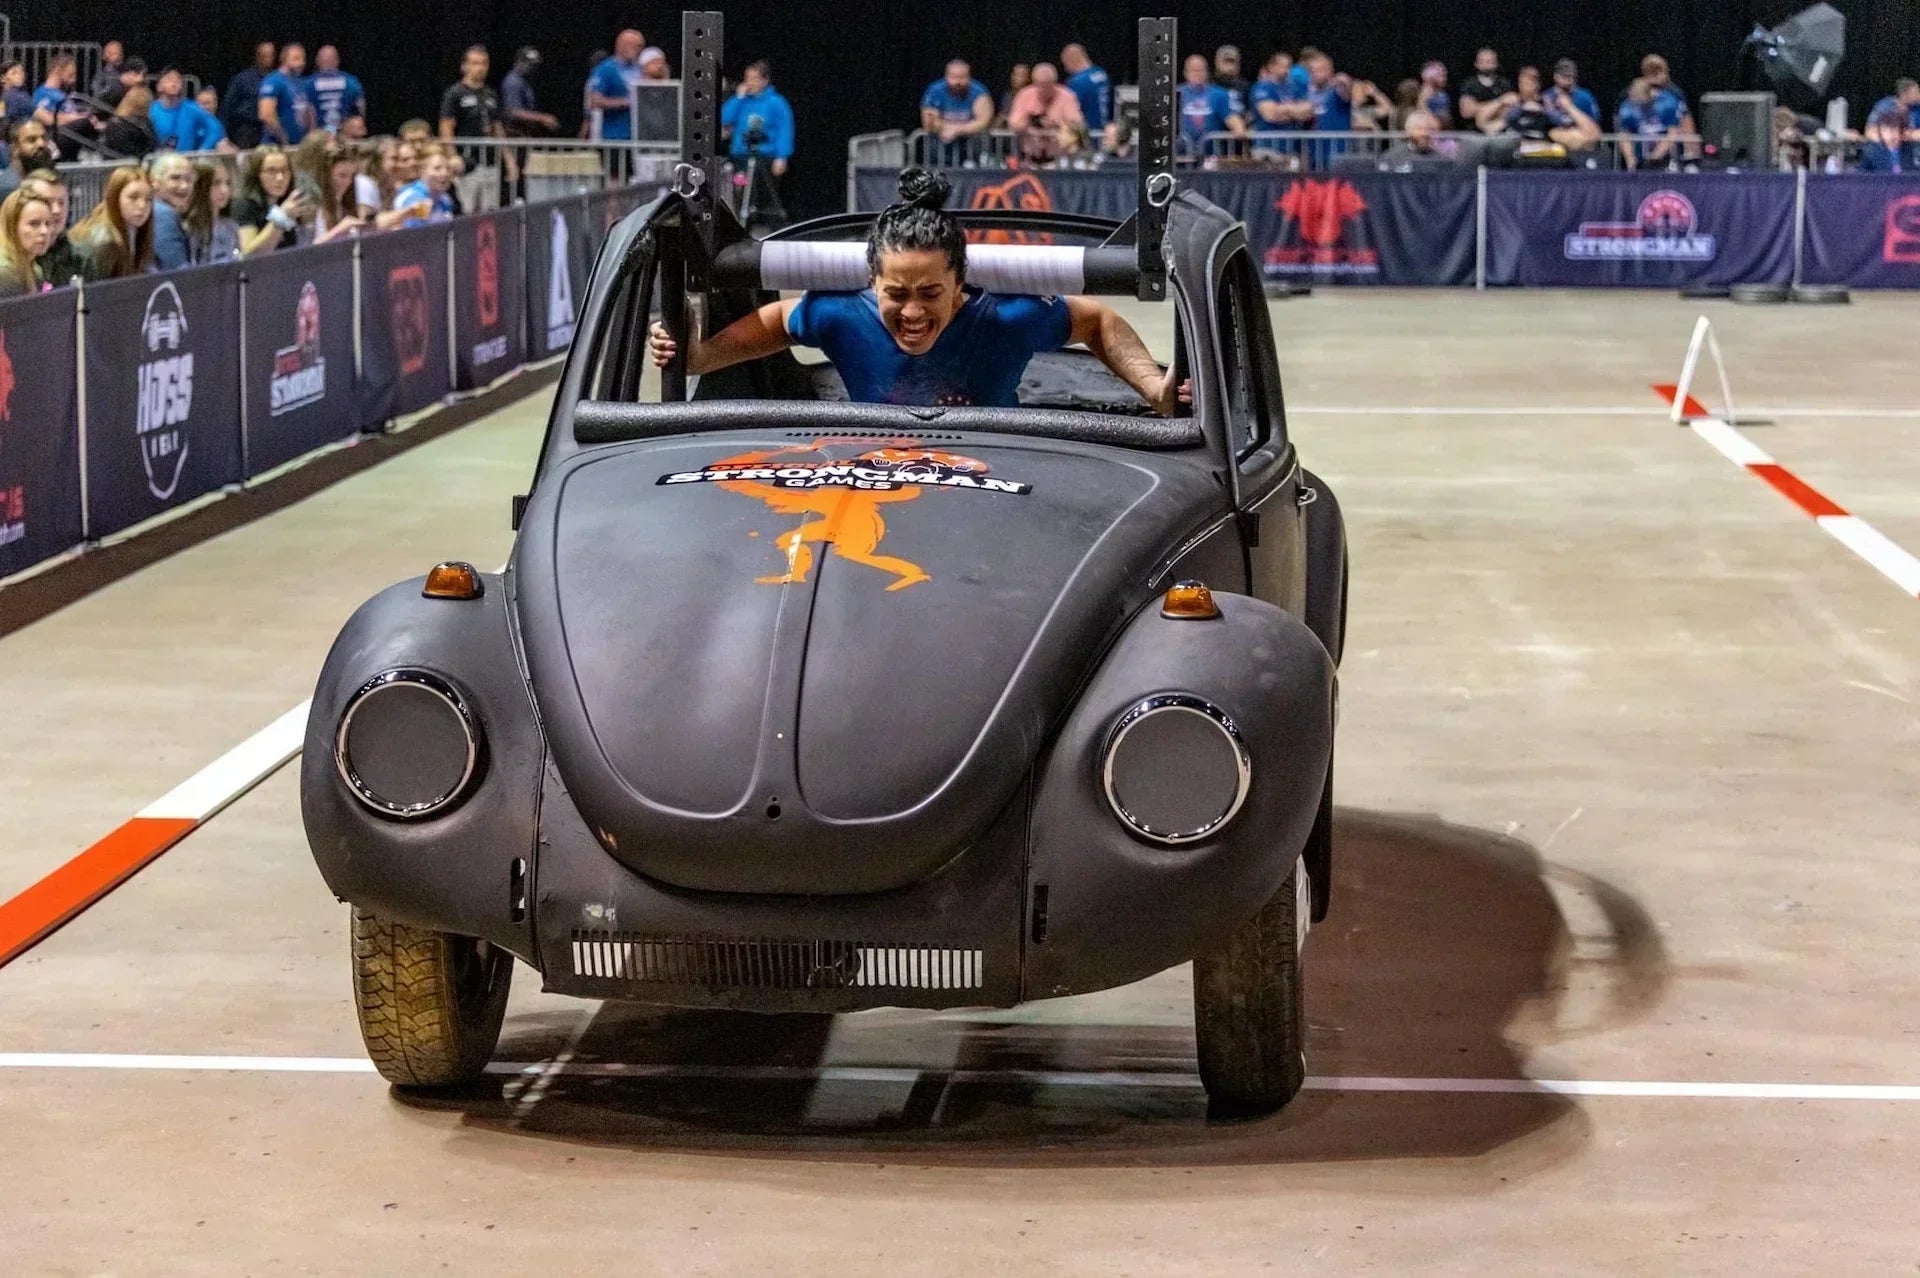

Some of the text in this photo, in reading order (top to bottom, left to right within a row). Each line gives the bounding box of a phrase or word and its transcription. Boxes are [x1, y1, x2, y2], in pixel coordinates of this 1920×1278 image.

[1164, 33, 1168, 41] 1
[1163, 54, 1170, 65] 2
[1163, 75, 1169, 83] 3
[1161, 115, 1169, 126] 5
[1161, 136, 1169, 146] 6
[1160, 155, 1168, 166] 7
[1567, 236, 1709, 257] STRONGMAN
[666, 465, 1025, 494] STRONGMAN
[785, 477, 893, 490] GAMES
